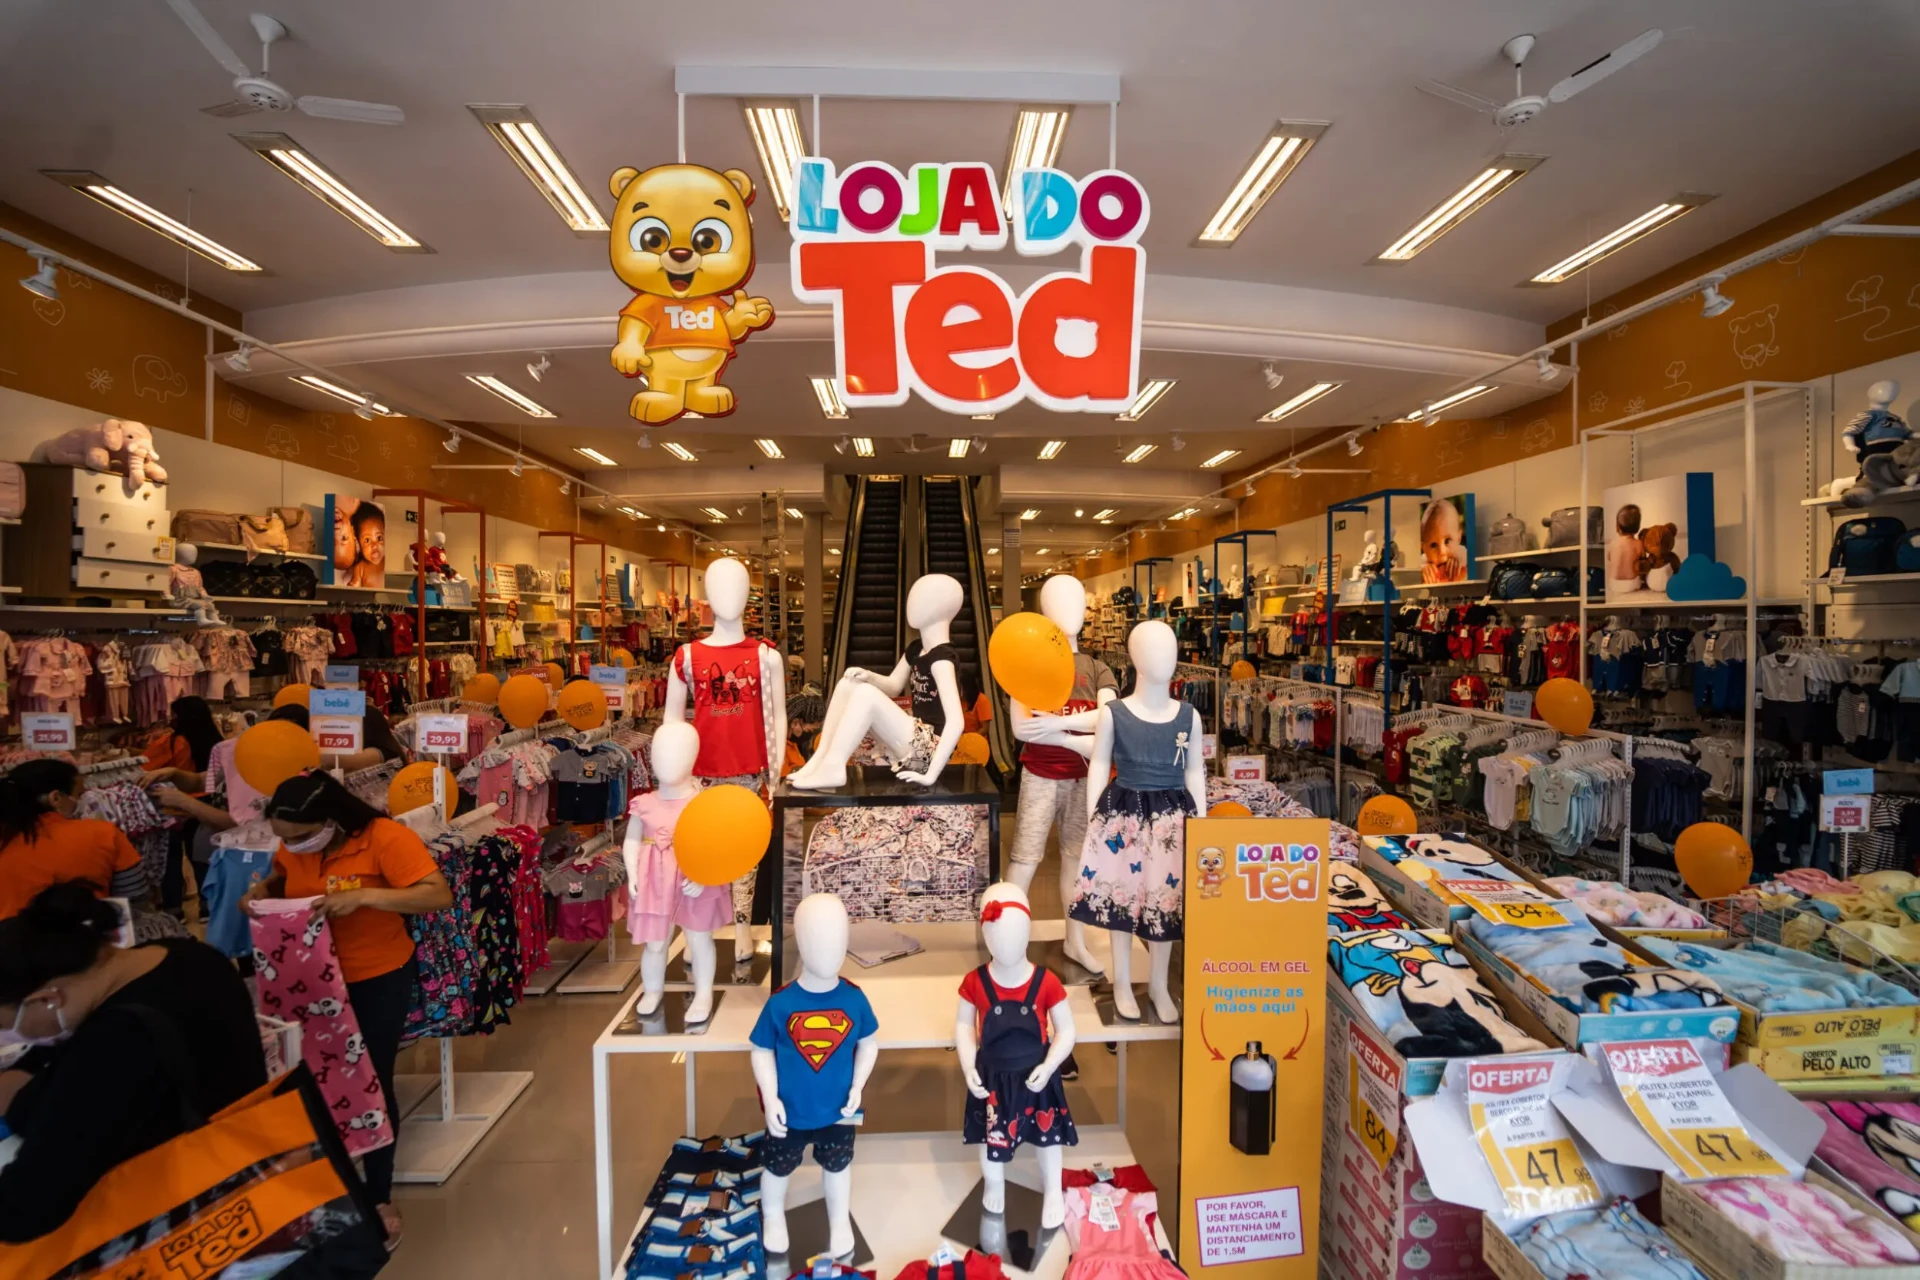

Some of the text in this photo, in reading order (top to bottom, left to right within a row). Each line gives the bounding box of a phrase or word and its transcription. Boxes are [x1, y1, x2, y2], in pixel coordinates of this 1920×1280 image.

[797, 163, 1142, 241] LOJA DO
[664, 305, 714, 331] Ted
[800, 240, 1137, 401] Ted
[324, 737, 349, 747] 17,99
[430, 735, 457, 744] 29,99
[1238, 845, 1319, 862] LOJA DO
[1238, 863, 1319, 900] Ted
[1446, 881, 1513, 891] OFERTA
[1501, 904, 1542, 918] 84
[1202, 958, 1311, 973] ÁLCOOL EM GEL
[1206, 985, 1304, 1001] Higienize as
[1262, 1001, 1296, 1016] aqui
[1350, 1031, 1397, 1090] OFERTA
[1609, 1046, 1698, 1069] OFERTA
[1803, 1050, 1837, 1059] COBERTOR
[1803, 1058, 1834, 1072] PELO
[1840, 1056, 1871, 1069] ALTO
[1471, 1066, 1550, 1089] OFERTA
[1637, 1080, 1714, 1092] JOLITEX COBERTOR
[1672, 1101, 1698, 1109] KYOR
[1365, 1110, 1387, 1153] 84
[1696, 1133, 1742, 1162] 47
[1526, 1148, 1565, 1186] 47
[1206, 1200, 1266, 1211] POR FAVOR,
[1207, 1214, 1226, 1222] USE
[1281, 1210, 1287, 1218] E
[1207, 1222, 1281, 1234] MANTENHA UM
[1207, 1232, 1296, 1245] DISTANCIAMENTO
[1207, 1246, 1246, 1256] DE 1,5M
